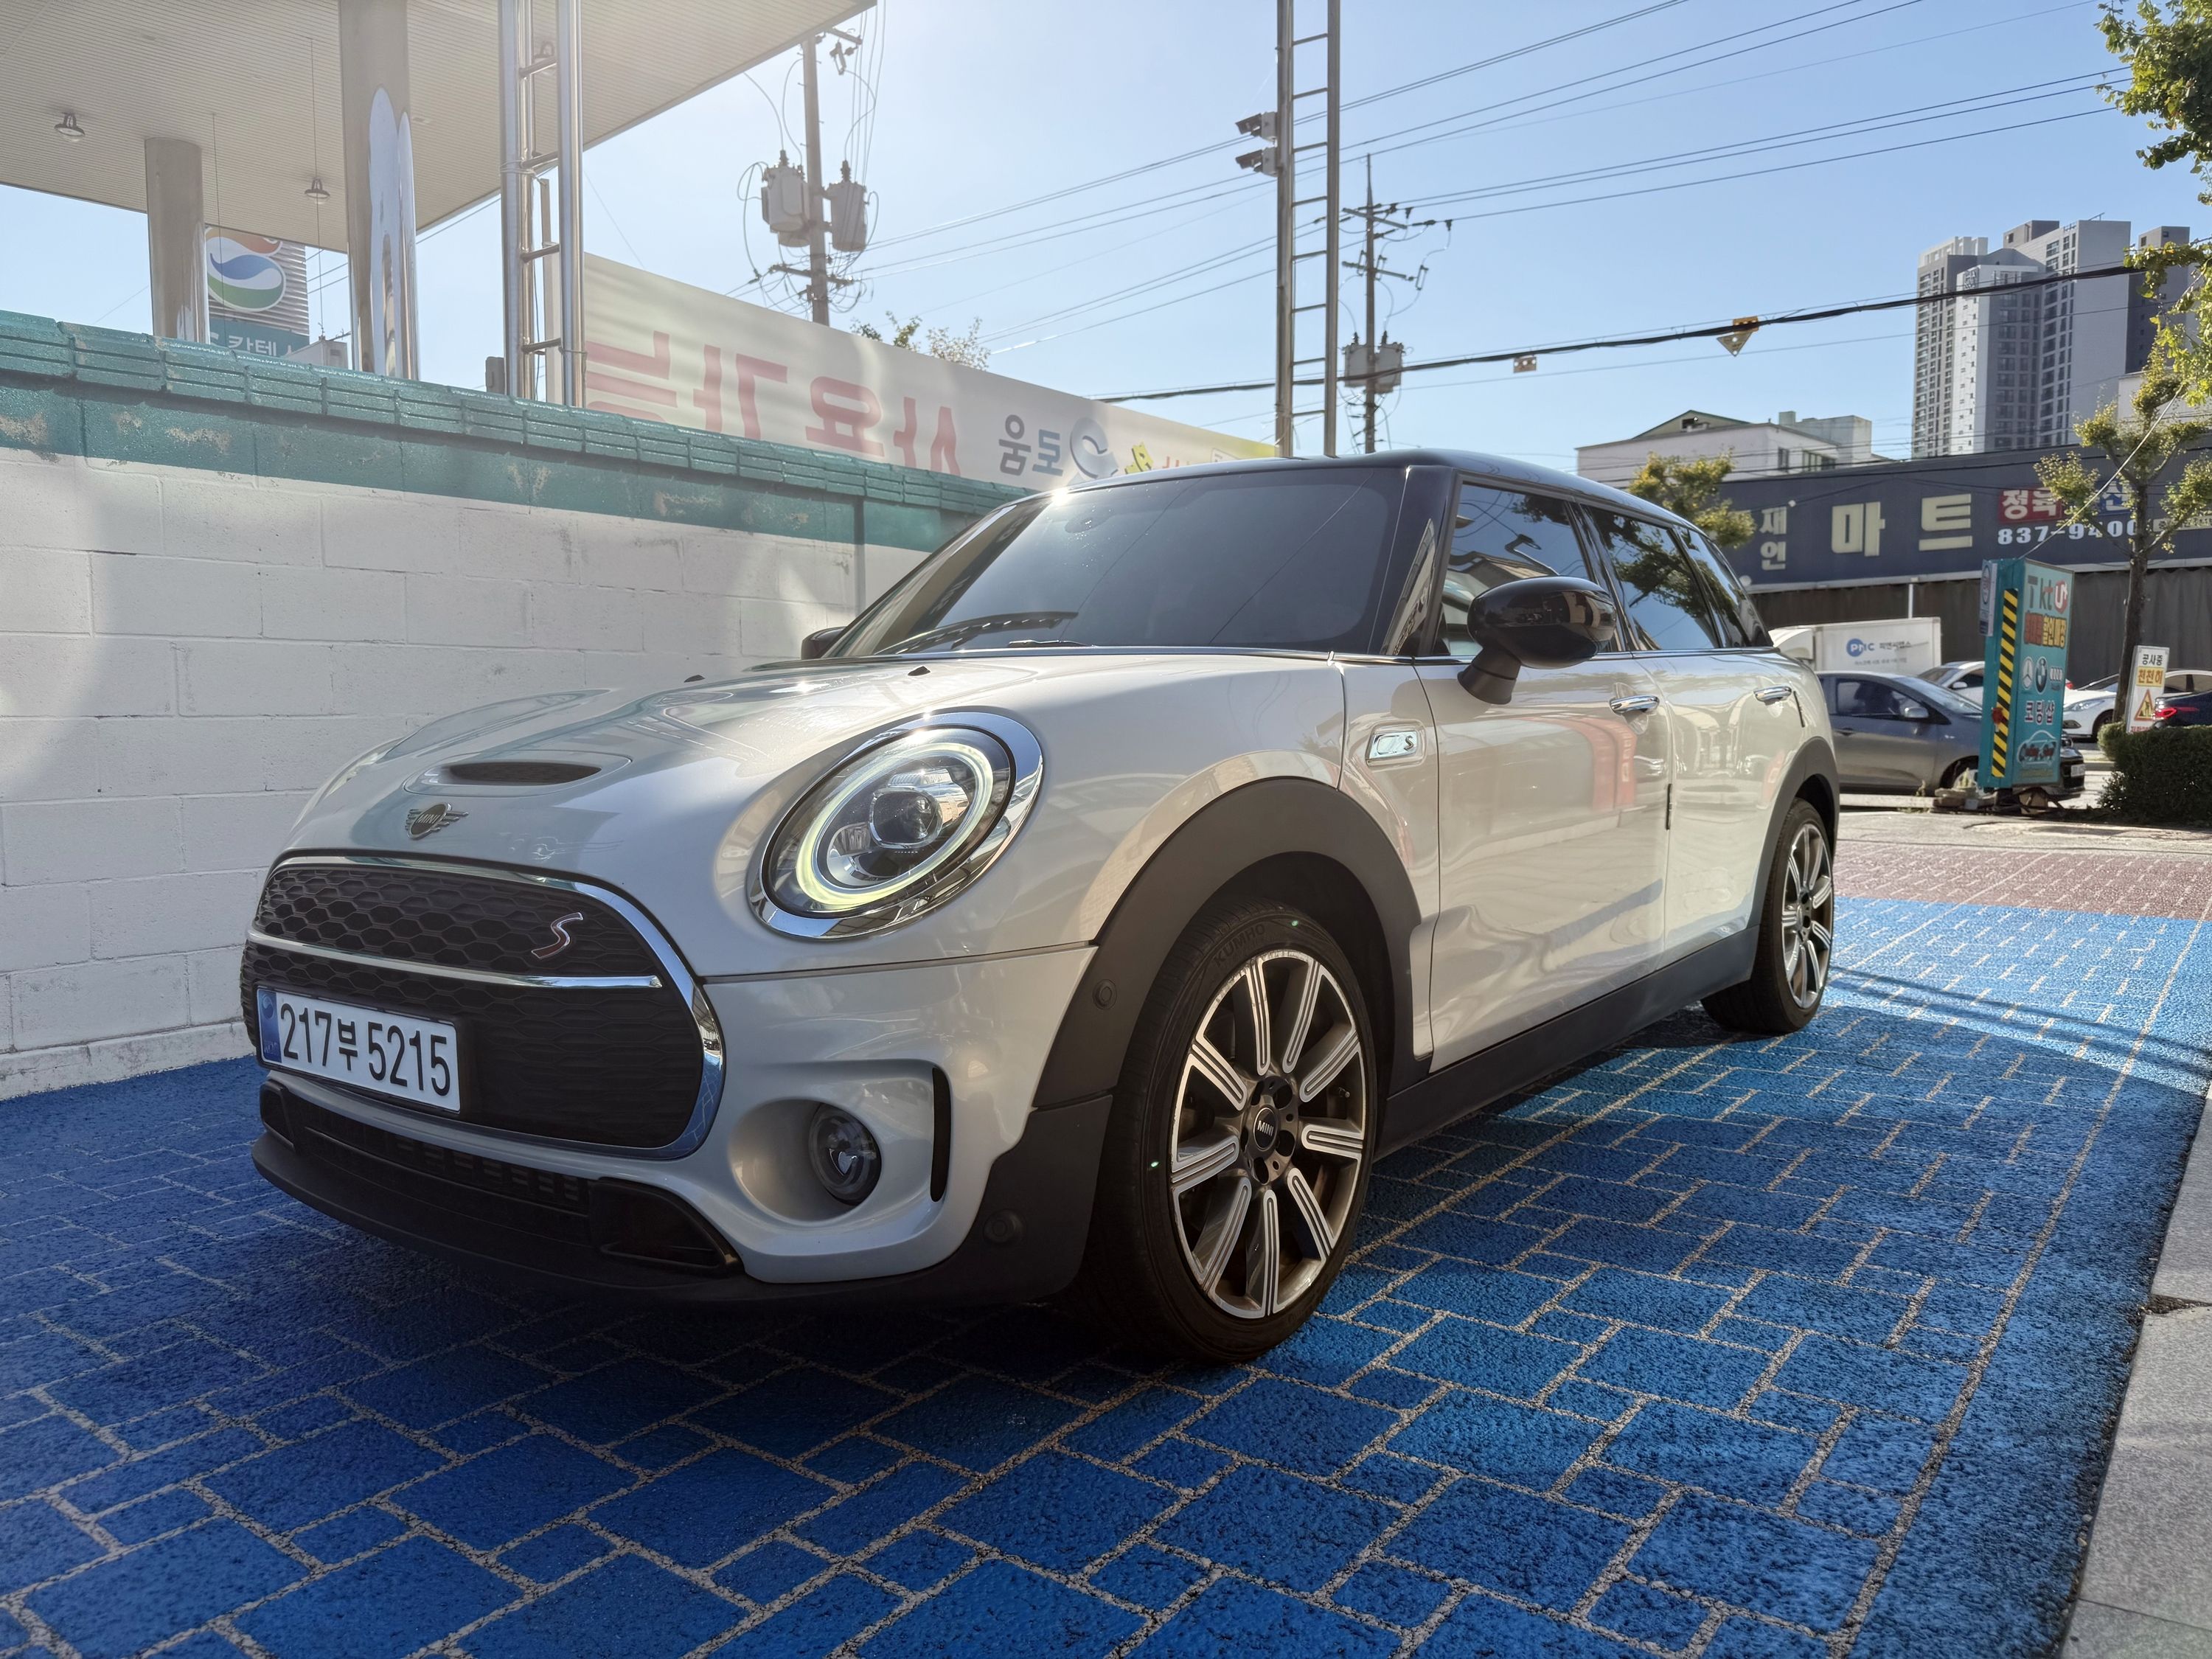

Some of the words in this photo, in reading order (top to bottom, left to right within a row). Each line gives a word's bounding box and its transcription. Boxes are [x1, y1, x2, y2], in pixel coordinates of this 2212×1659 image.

[1832, 493, 1972, 557] 마트
[2142, 653, 2163, 666] 공사중
[2138, 669, 2163, 684] 천천히
[414, 813, 441, 824] MINI
[530, 911, 584, 961] S
[1214, 923, 1266, 967] KUMHO
[1257, 1120, 1274, 1136] MINI
